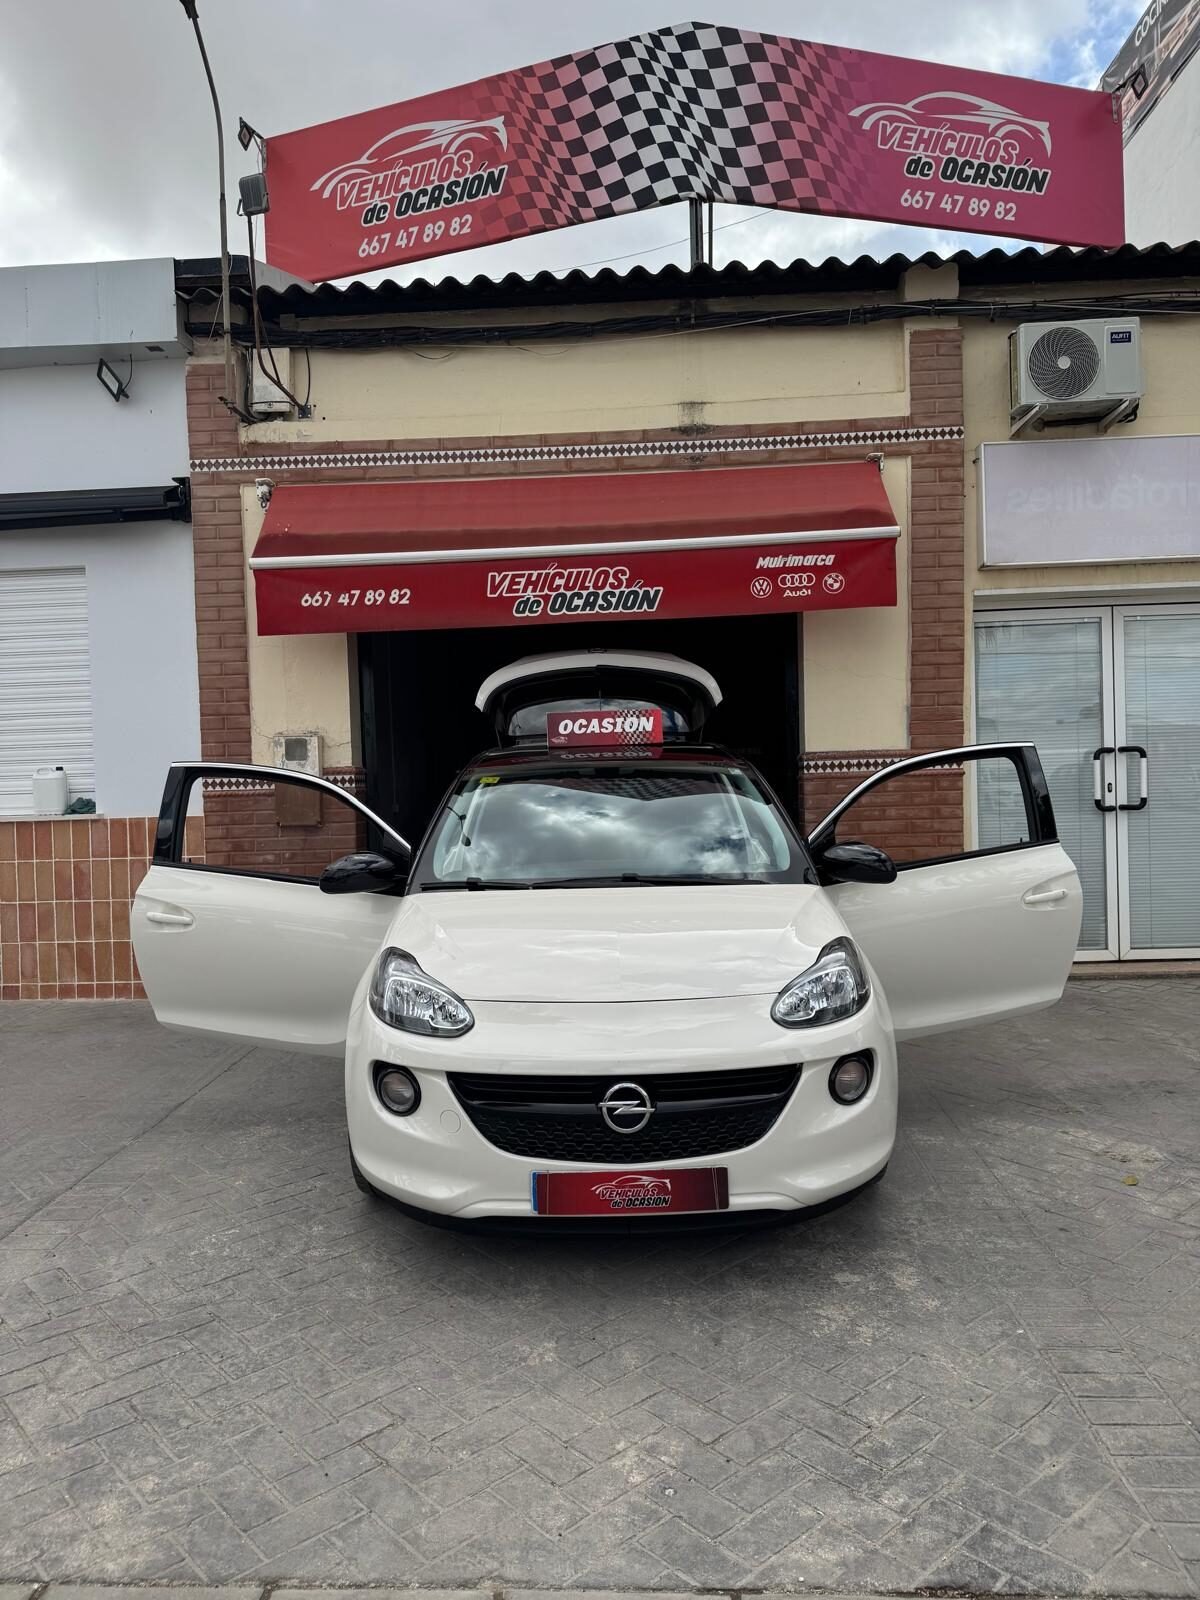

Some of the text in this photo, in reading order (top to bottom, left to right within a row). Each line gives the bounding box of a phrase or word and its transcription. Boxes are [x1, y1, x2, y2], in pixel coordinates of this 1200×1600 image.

[878, 121, 1019, 165] VEHÍCULOS
[337, 150, 473, 210] VEHÍCULOS
[905, 156, 1051, 194] de OCASIÓN
[361, 163, 508, 227] de OCASIÓN
[900, 188, 1017, 221] 667 47 89 82
[358, 214, 473, 257] 667 47 89 82
[300, 589, 411, 607] 667 47 89 82
[487, 562, 629, 597] VEHÍCULOS
[513, 579, 663, 616] de OCASIÓN
[783, 589, 812, 597] Audi
[611, 1199, 624, 1208] de
